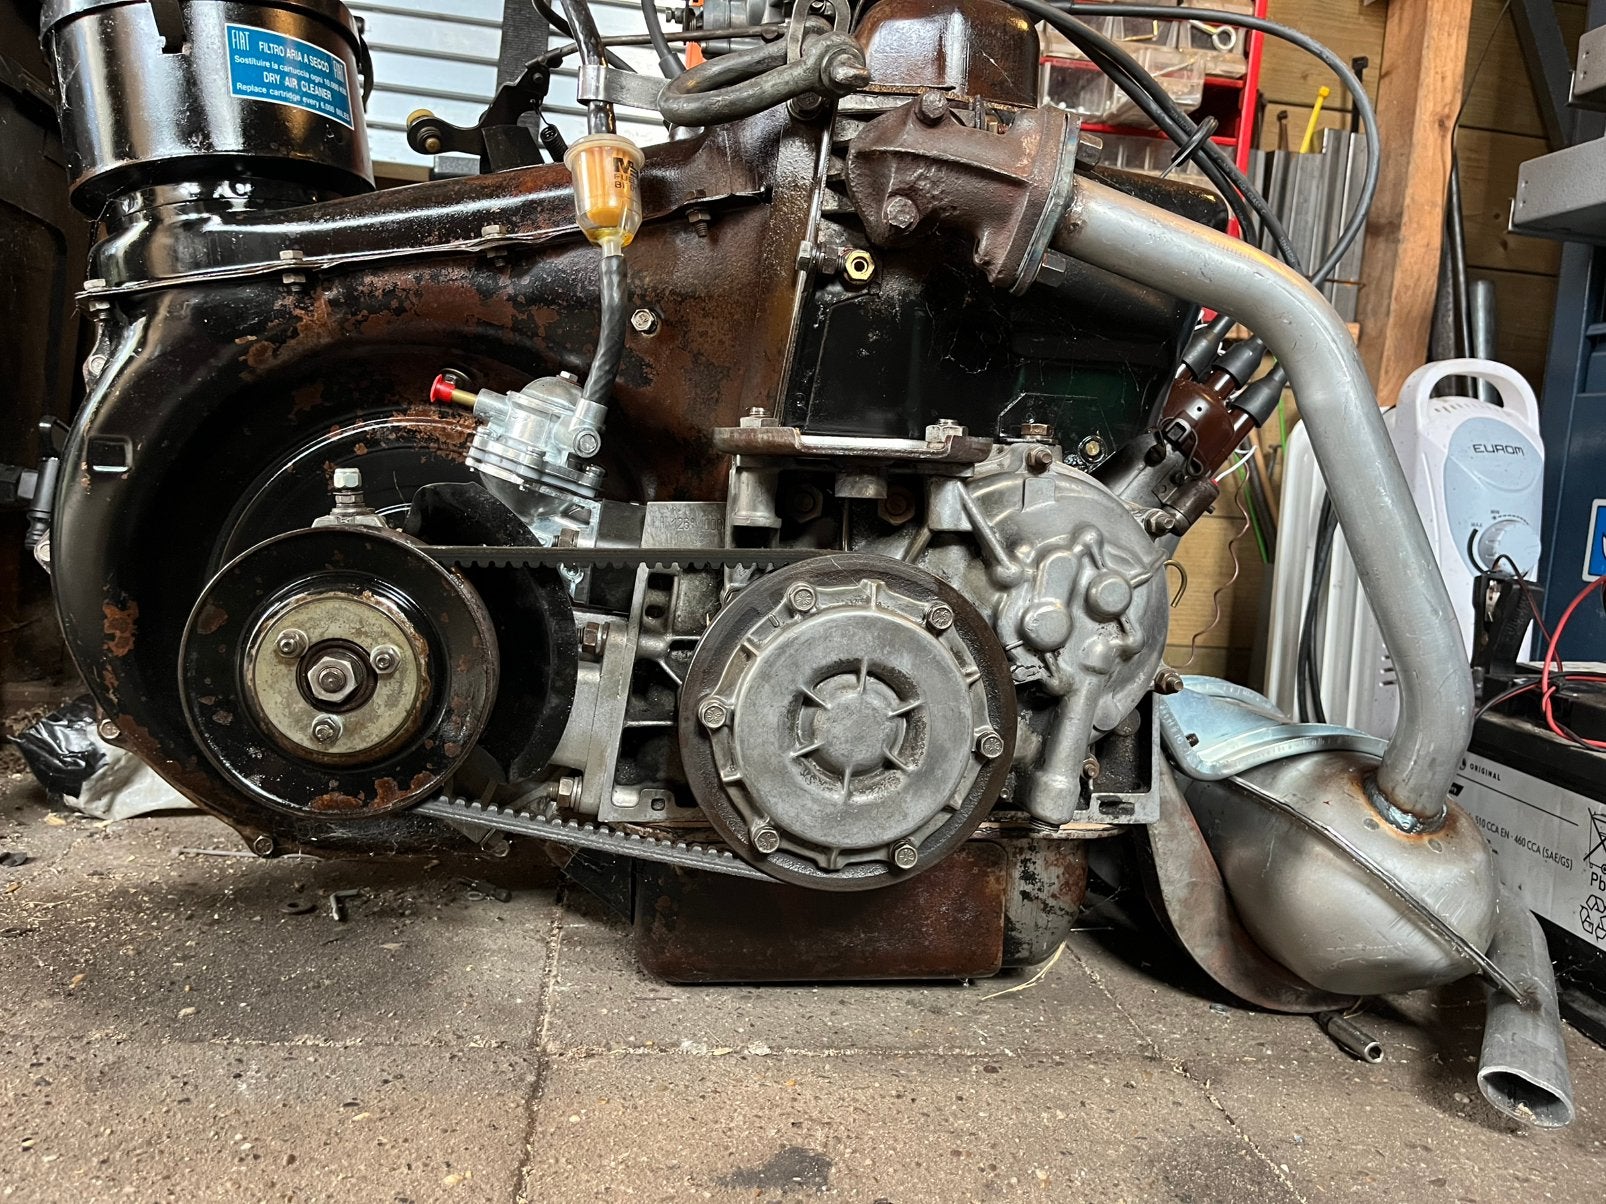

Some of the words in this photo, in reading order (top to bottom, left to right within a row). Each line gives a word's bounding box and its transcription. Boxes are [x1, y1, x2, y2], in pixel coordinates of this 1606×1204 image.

[231, 29, 250, 51] FIAT
[234, 55, 270, 68] Sostituire
[271, 61, 279, 70] la
[279, 64, 310, 79] cartuccia
[259, 41, 285, 57] FILTRO
[286, 48, 303, 62] ARIA
[304, 53, 309, 65] A
[309, 55, 329, 73] SECCO
[236, 82, 267, 94] Replace
[269, 88, 301, 102] cartridge
[263, 71, 280, 85] DRY
[284, 76, 299, 90] AIR
[300, 80, 333, 101] CLEANER
[1472, 443, 1525, 456] EUROM
[1469, 763, 1502, 782] ORIGINAL
[1486, 821, 1500, 836] CCA
[1500, 827, 1510, 840] EN
[1514, 834, 1526, 848] 460
[1526, 840, 1542, 856] CCA
[1542, 846, 1574, 872] (SAE/GS)
[1590, 871, 1606, 892] Pb
